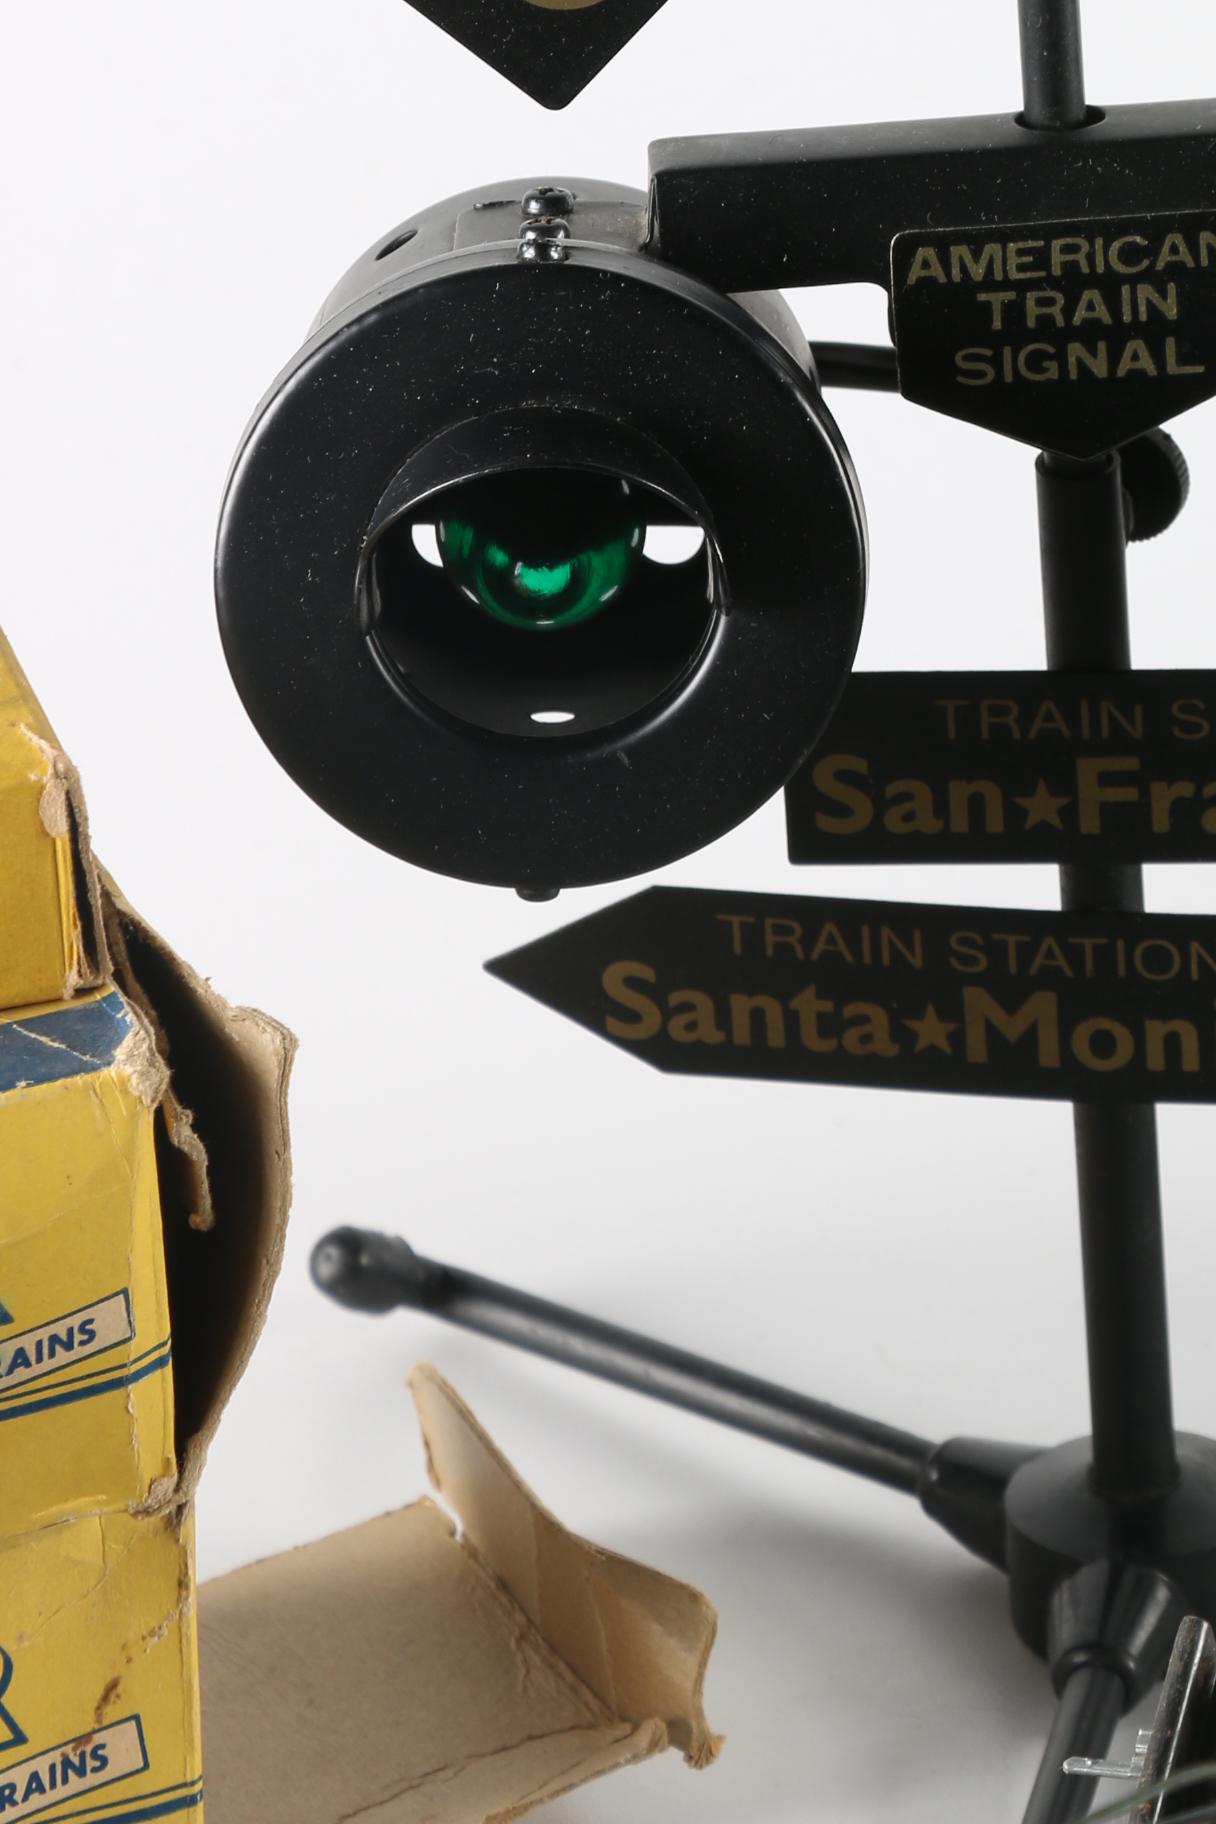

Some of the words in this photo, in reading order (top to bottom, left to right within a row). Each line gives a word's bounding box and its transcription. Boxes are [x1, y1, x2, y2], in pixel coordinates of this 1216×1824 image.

[977, 281, 1178, 331] TRAIN
[954, 336, 1206, 386] SIGNAL
[934, 698, 1144, 743] TRAIN
[811, 754, 1007, 837] San
[716, 913, 923, 969] TRAIN
[599, 960, 902, 1056] Santa
[0, 1317, 97, 1378] AINS
